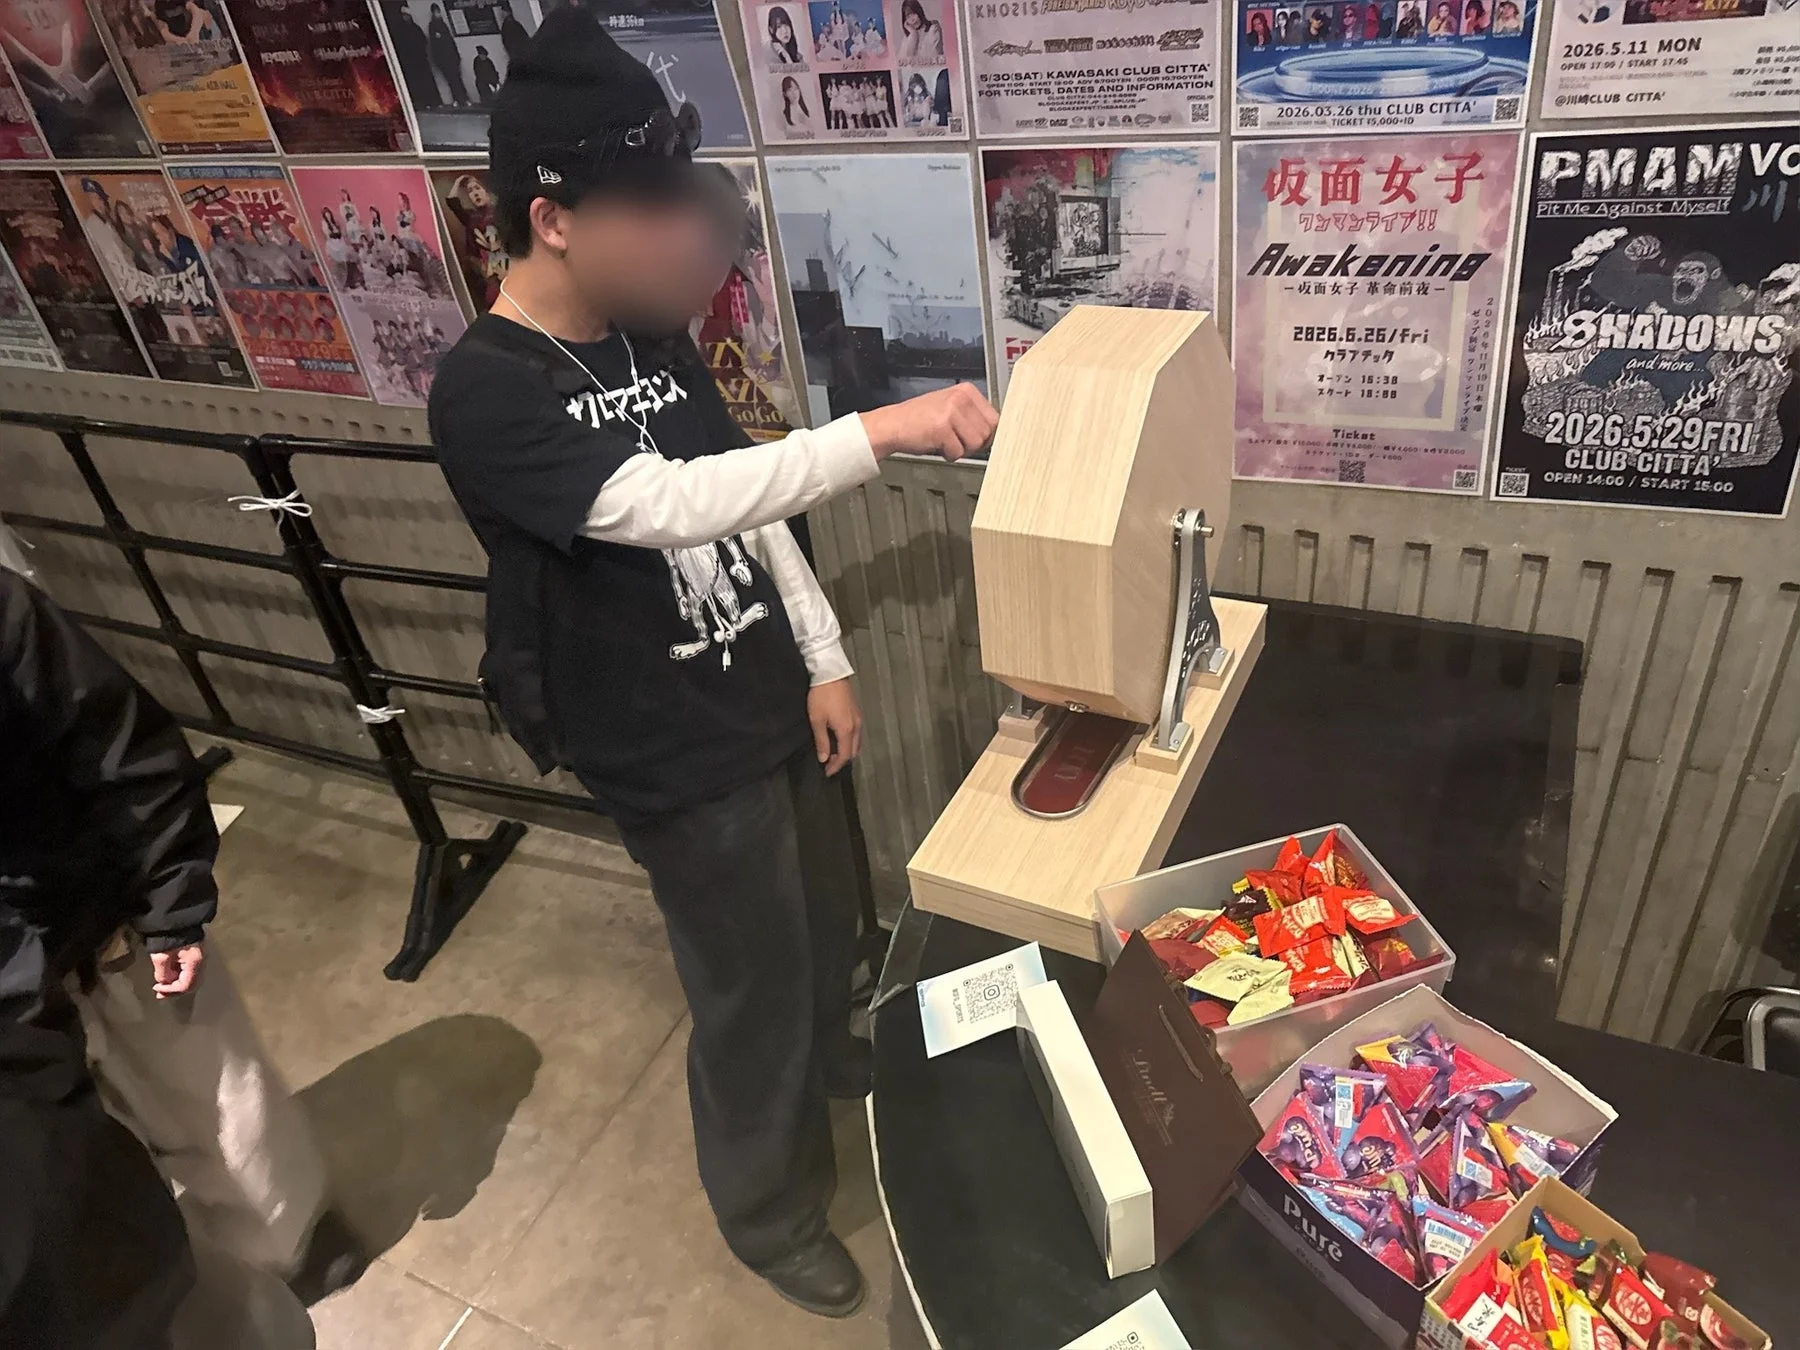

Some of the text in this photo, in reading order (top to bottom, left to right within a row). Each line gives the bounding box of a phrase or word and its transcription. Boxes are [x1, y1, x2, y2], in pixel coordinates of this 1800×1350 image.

[1563, 37, 1702, 58] 2026.5.11 MON
[979, 71, 1043, 83] 5/30(SAT)
[1046, 67, 1120, 79] KAWASAKI
[1122, 65, 1161, 76] CLUB
[1560, 62, 1586, 71] OPEN
[1627, 58, 1658, 68] START
[978, 90, 1002, 98] FOR
[1057, 86, 1095, 95] DATES
[1098, 84, 1124, 93] AND
[1126, 81, 1214, 92] INFORMATION
[1276, 104, 1354, 118] 2026.03.26
[1358, 104, 1382, 116] thu
[1386, 103, 1424, 115] CLUB
[1331, 117, 1364, 126] TICKET
[1261, 151, 1485, 207] 仮面女子
[1536, 142, 1744, 199] PMAM
[1537, 199, 1730, 219] Pit Me Against Myself
[1247, 243, 1493, 282] Awakening
[1549, 306, 1785, 354] SHADOWS
[1323, 349, 1396, 364] クラブチッタ
[1333, 429, 1377, 441] Ticket
[1544, 411, 1756, 455] 2026.5.29FRI
[1565, 448, 1628, 471] CLUB
[1544, 472, 1583, 485] OPEN
[1640, 477, 1689, 492] START
